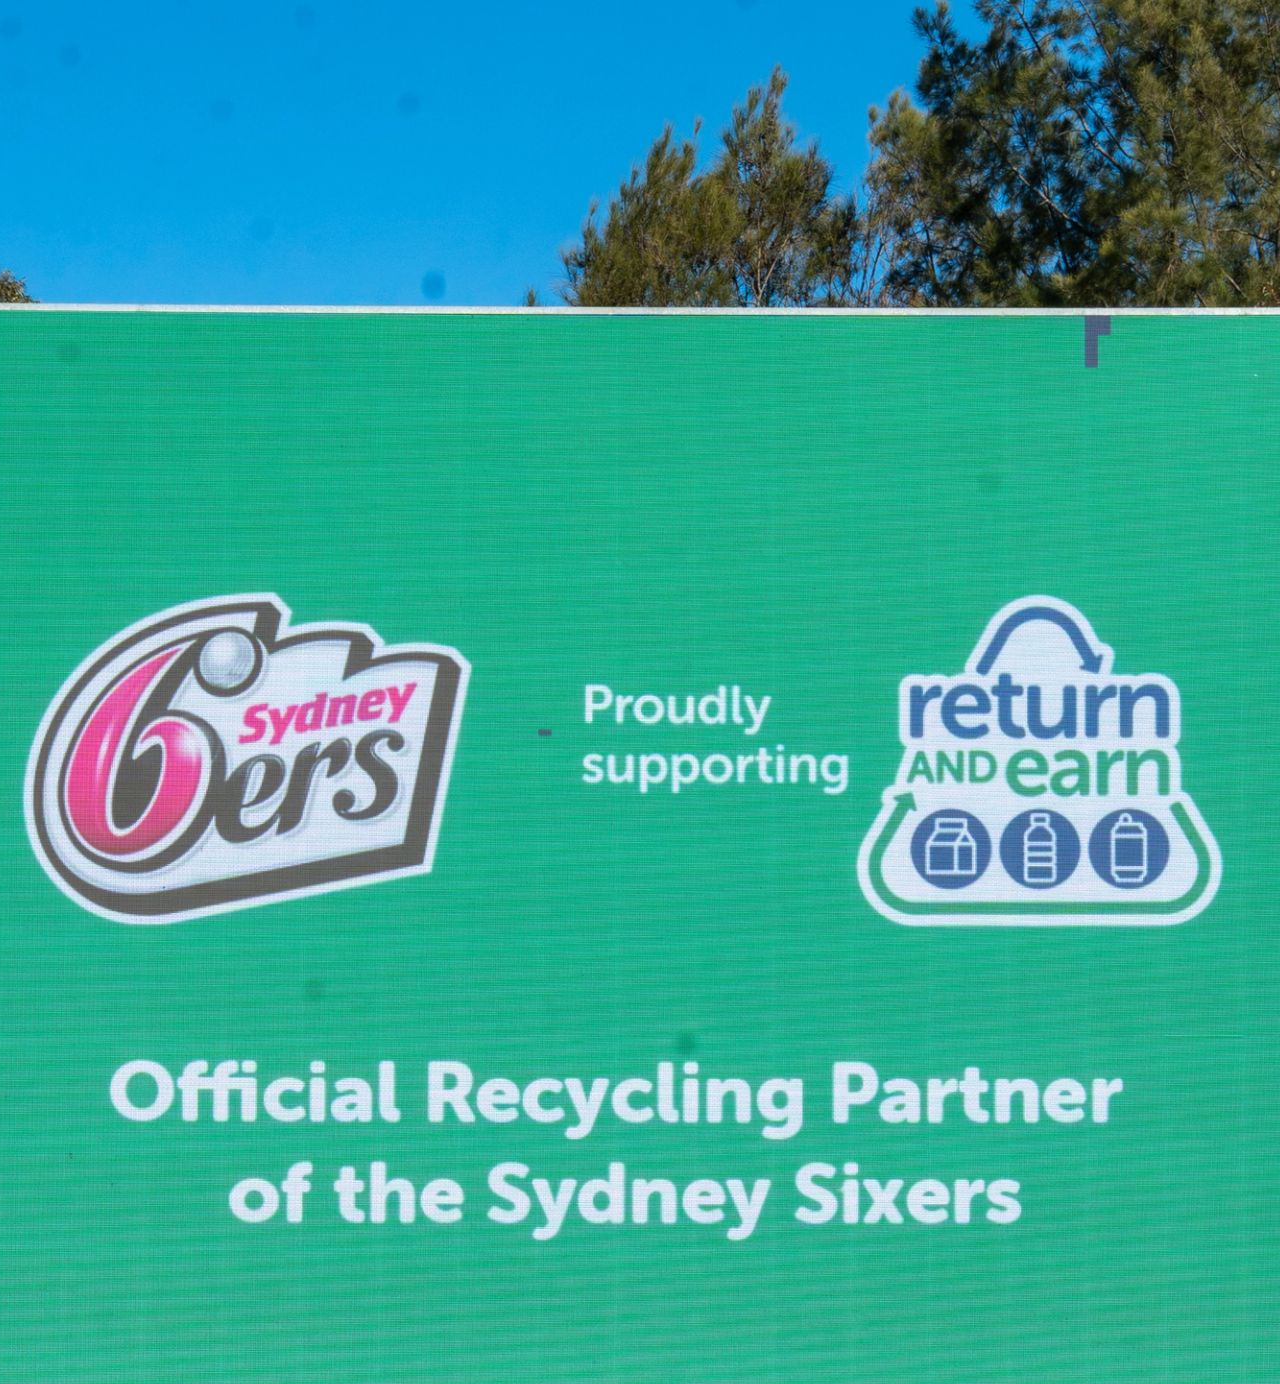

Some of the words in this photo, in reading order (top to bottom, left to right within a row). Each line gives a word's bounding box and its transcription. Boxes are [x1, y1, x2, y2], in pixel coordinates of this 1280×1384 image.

[238, 681, 418, 746] Sydney
[583, 684, 771, 734] Proudly
[909, 672, 1170, 740] return
[58, 627, 405, 874] 6ers
[582, 745, 849, 794] supporting
[906, 750, 997, 784] AND
[1005, 749, 1170, 797] earn
[109, 1059, 400, 1122] Official
[428, 1061, 803, 1140] Recycling
[833, 1062, 1123, 1123] Partner
[228, 1162, 312, 1223] of
[334, 1161, 464, 1223] the
[487, 1162, 770, 1241] Sydney
[796, 1163, 1022, 1224] Sixers
